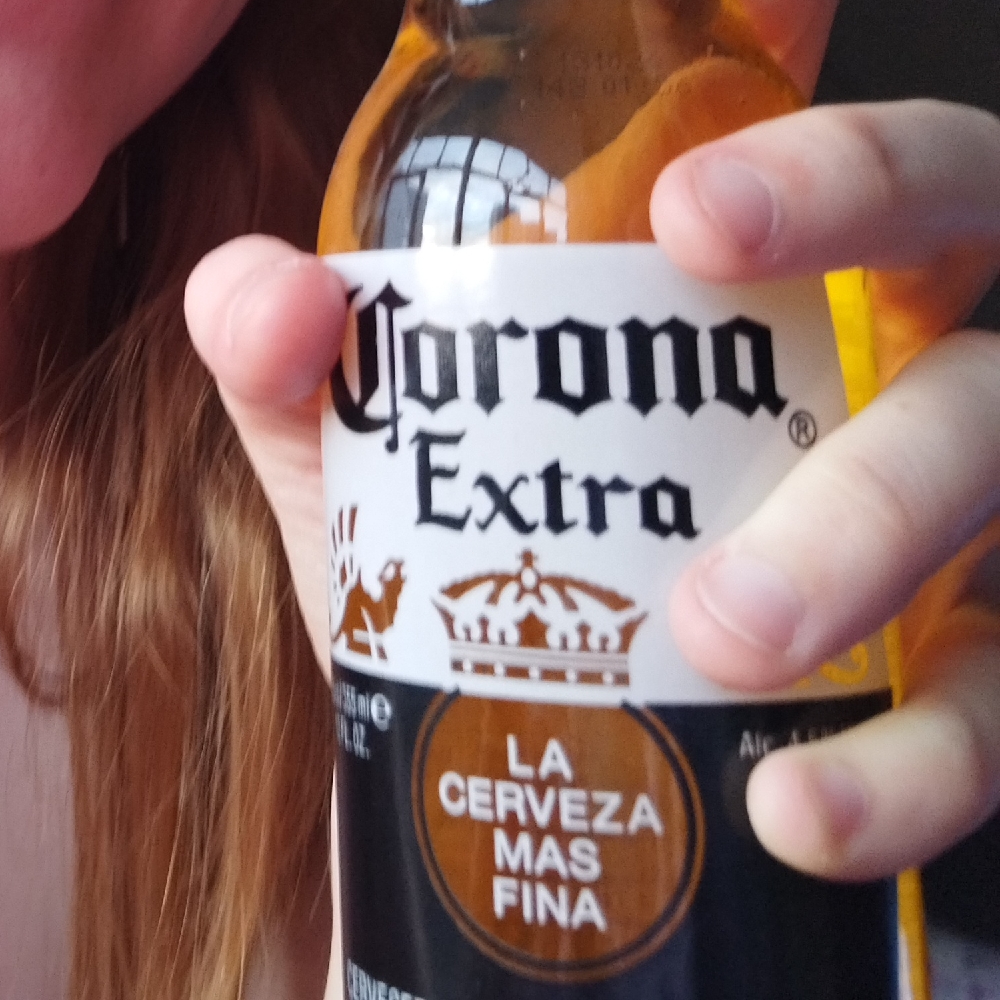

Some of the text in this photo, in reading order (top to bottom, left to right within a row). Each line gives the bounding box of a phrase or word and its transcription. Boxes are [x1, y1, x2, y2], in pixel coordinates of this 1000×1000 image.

[330, 280, 788, 452] Corona
[408, 427, 701, 541] Extra
[506, 733, 574, 782] LA
[438, 770, 665, 836] CERVEZA
[493, 827, 603, 883] MAS
[492, 874, 608, 932] FINA
